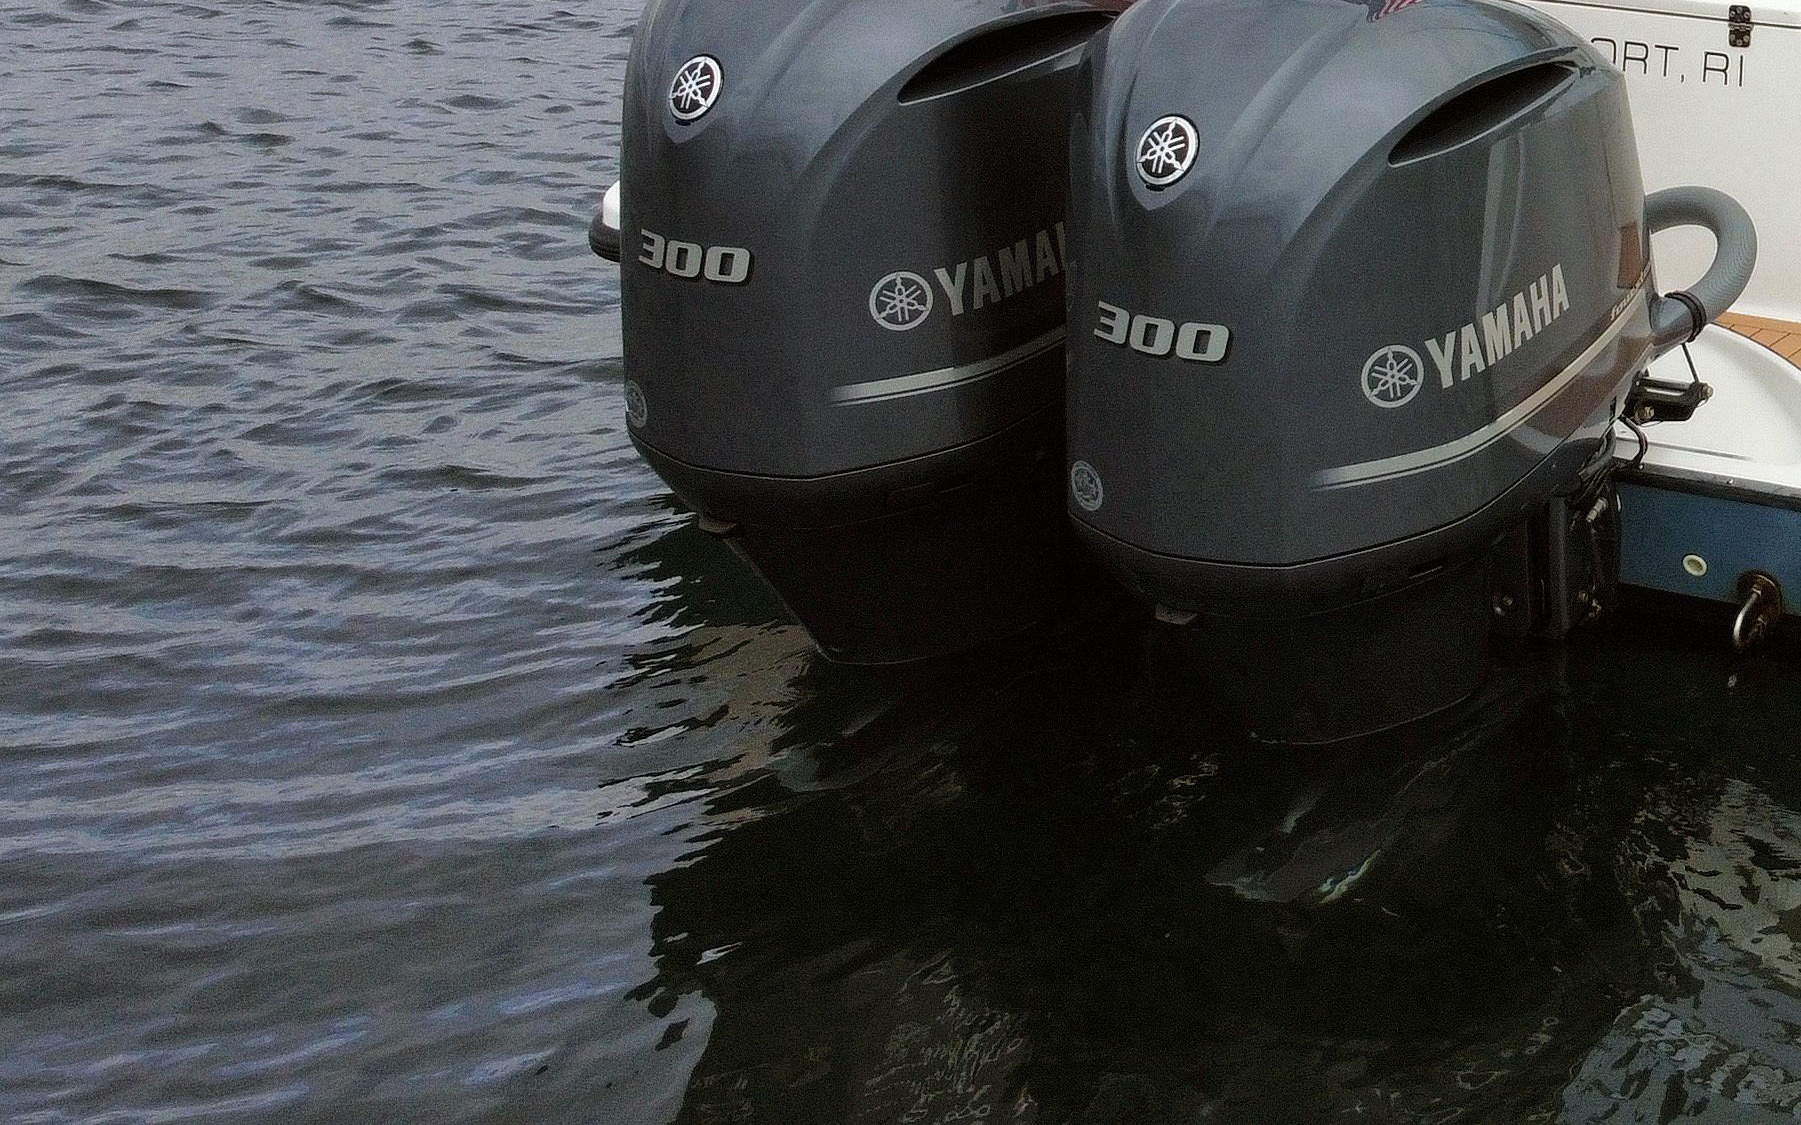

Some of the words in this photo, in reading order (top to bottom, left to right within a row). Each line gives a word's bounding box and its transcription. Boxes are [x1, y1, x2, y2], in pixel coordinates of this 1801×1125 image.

[1703, 51, 1743, 87] RI
[638, 228, 751, 283] 300
[1093, 300, 1230, 362] 300
[1424, 263, 1570, 389] YAMAHA
